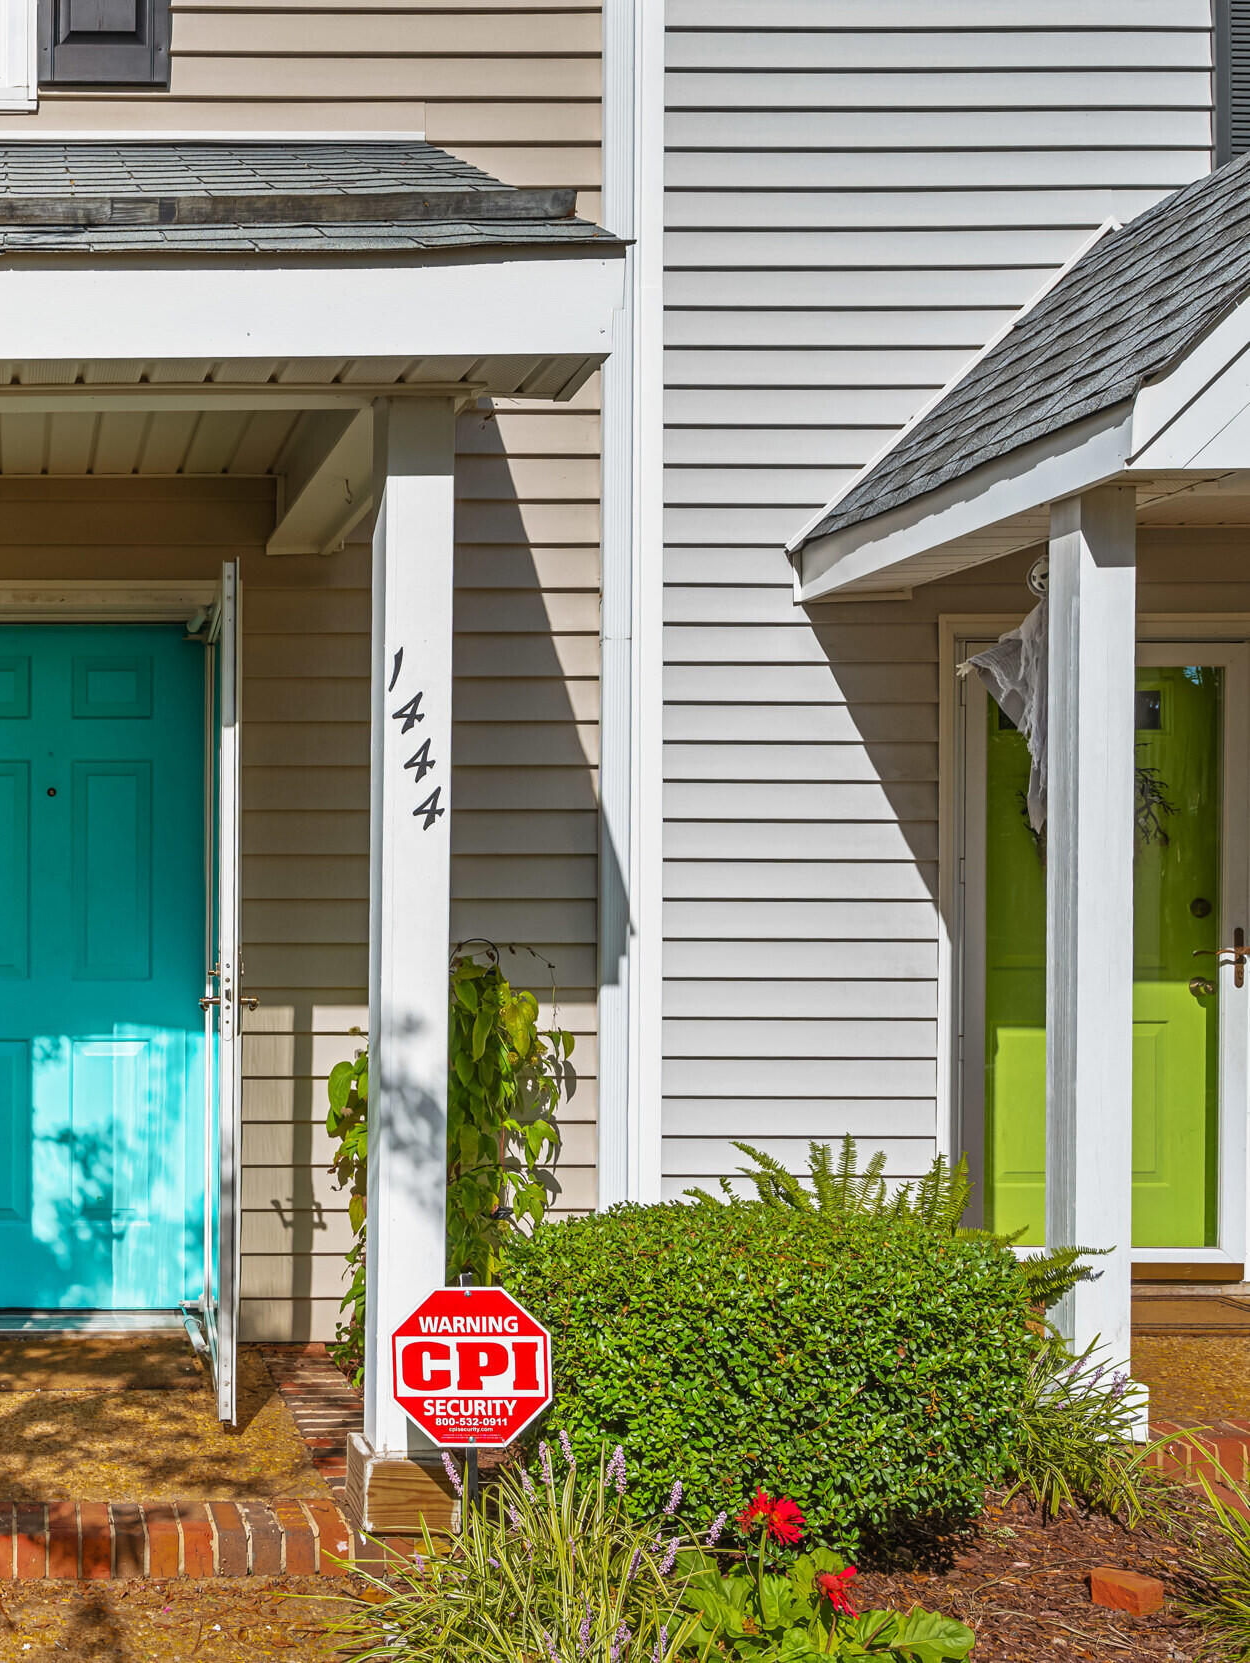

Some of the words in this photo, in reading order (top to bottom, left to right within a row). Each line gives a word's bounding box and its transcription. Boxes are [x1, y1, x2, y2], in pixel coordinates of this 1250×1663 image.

[388, 646, 445, 831] 1444
[418, 1316, 519, 1333] WARNING
[401, 1341, 540, 1391] CPI
[423, 1399, 518, 1416] SECURITY
[435, 1417, 508, 1426] 800-532-0911
